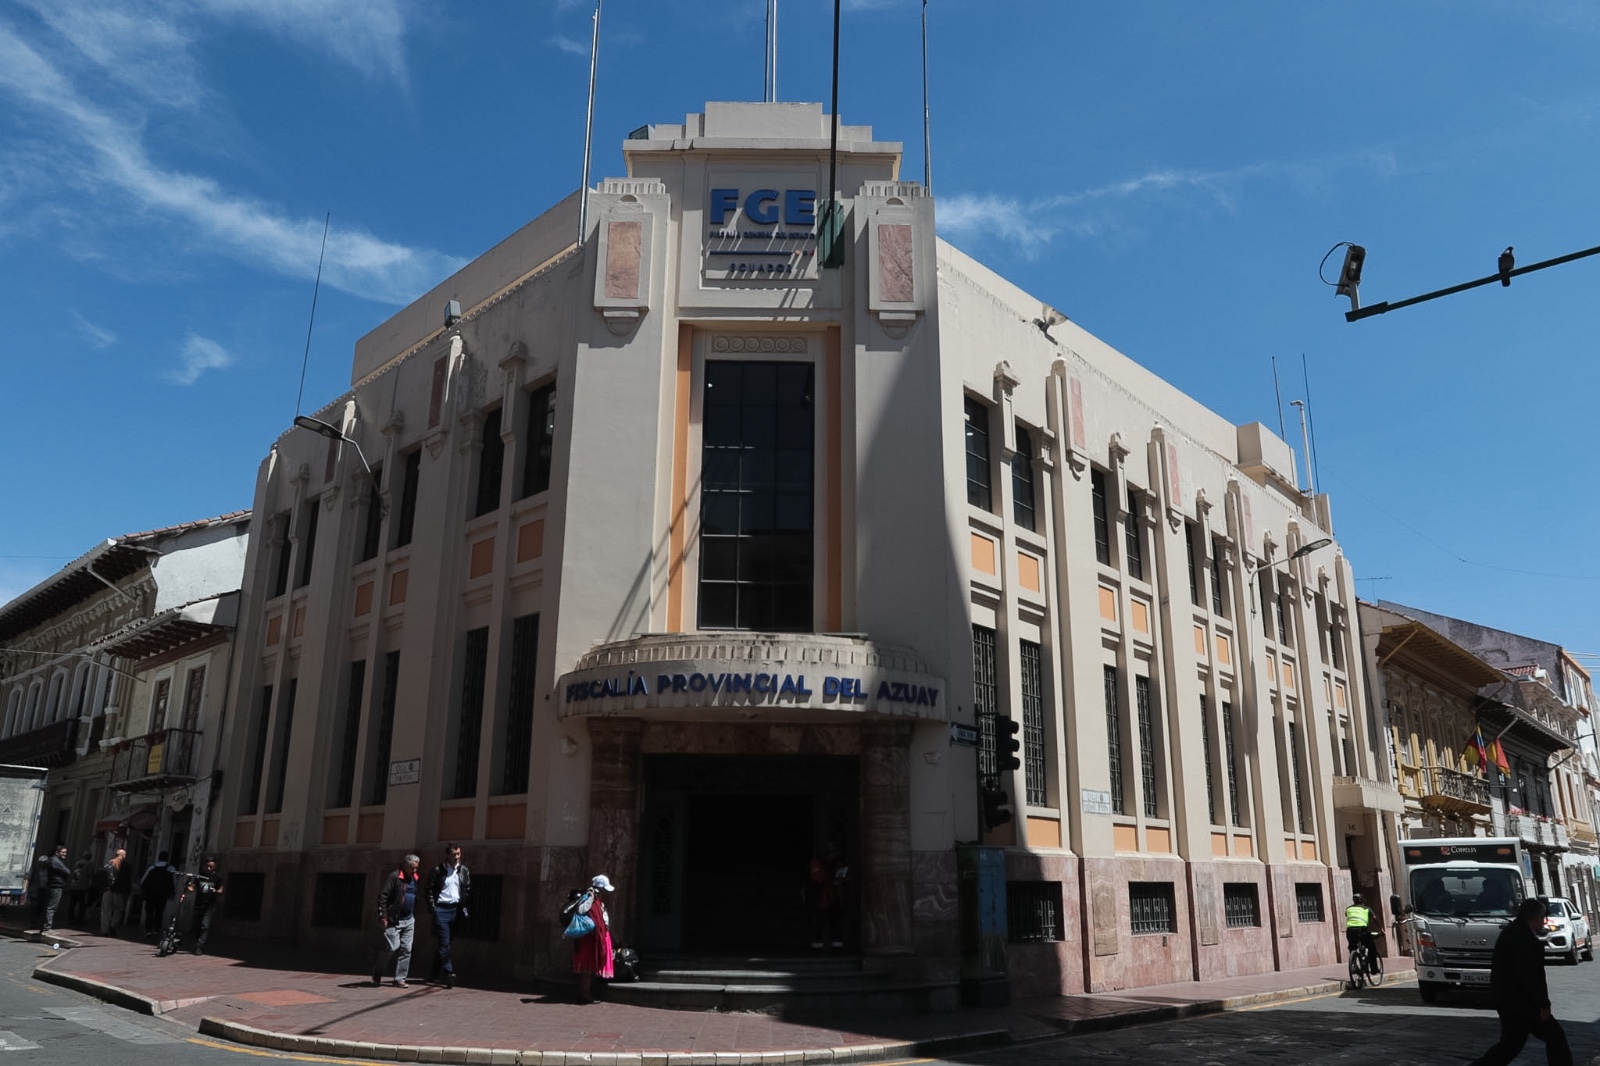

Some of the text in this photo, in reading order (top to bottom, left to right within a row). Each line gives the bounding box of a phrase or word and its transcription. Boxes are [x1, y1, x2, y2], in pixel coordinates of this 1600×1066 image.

[710, 188, 816, 226] FGE
[730, 263, 793, 273] ECUADOR
[566, 669, 939, 708] FISCALÍA PROVINCIAL DEL AZUAY
